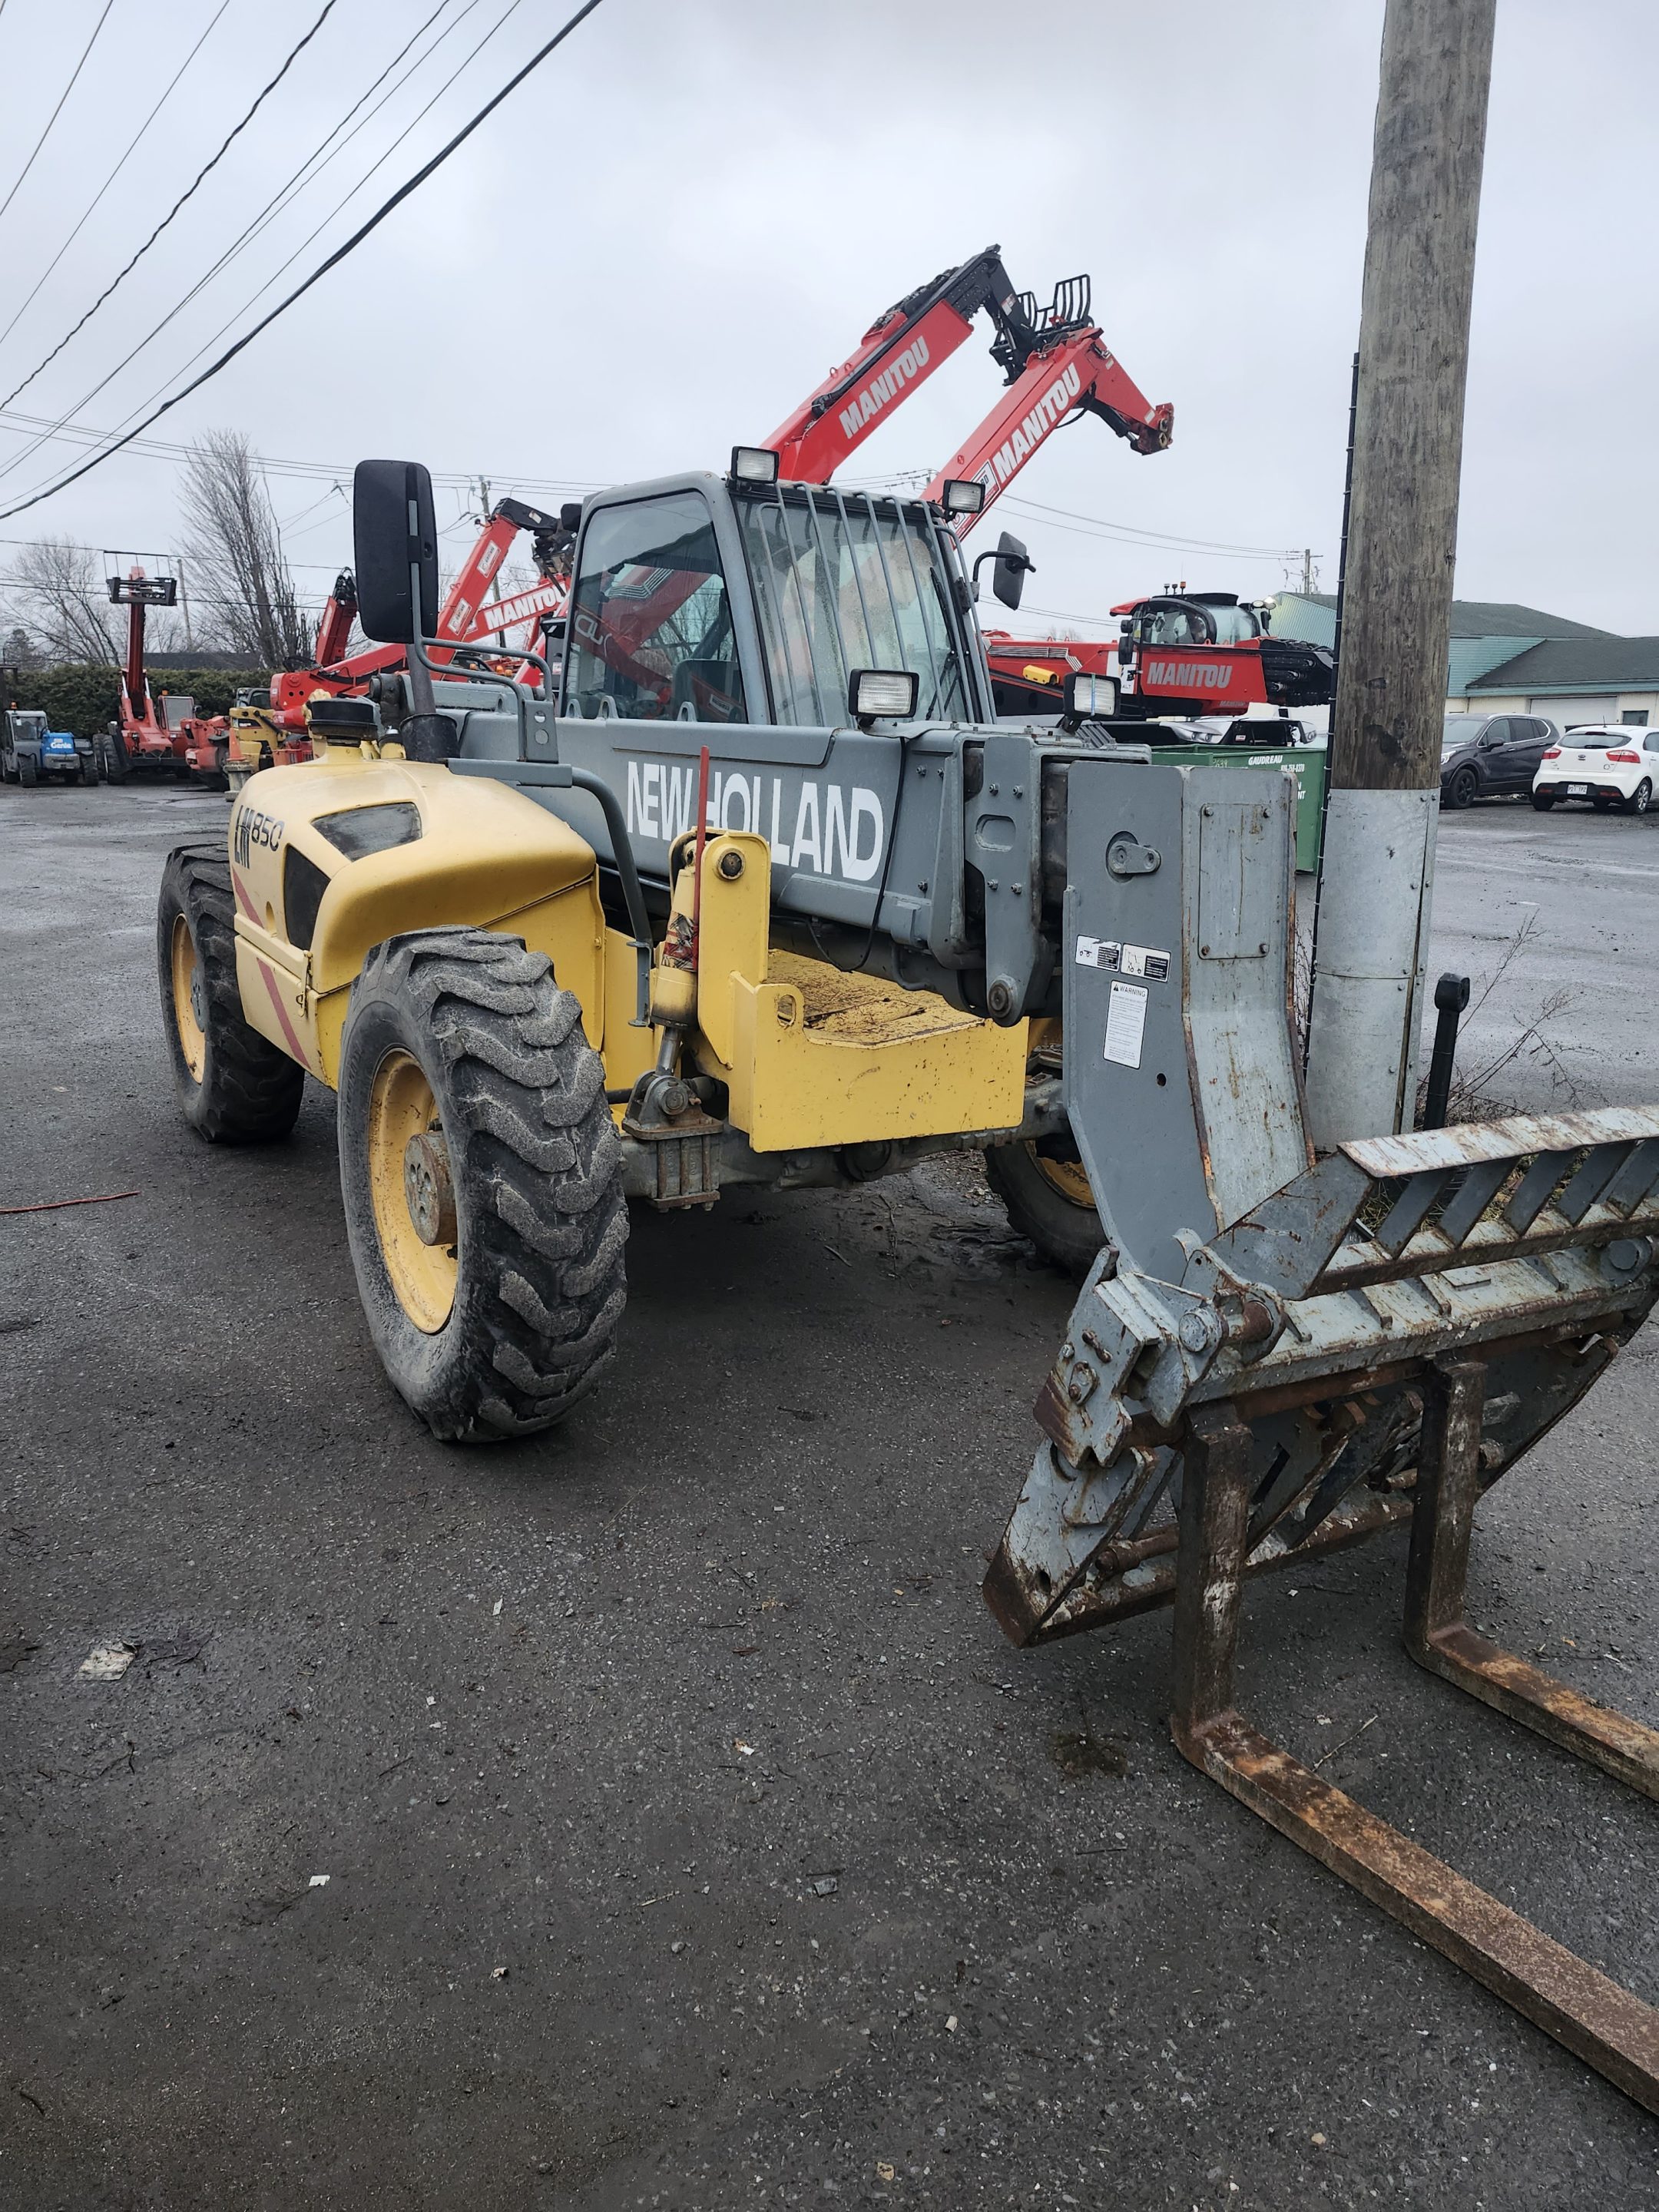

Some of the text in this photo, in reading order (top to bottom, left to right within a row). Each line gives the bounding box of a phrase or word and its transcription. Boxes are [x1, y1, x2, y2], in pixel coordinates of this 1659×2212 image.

[838, 335, 929, 439] MANITOU
[992, 362, 1081, 484] MANITOU
[1147, 662, 1233, 689] MANITOU
[1248, 754, 1283, 766] GAUDREAU
[627, 761, 884, 882] NEW HOLLAND
[1120, 985, 1146, 997] WARNING
